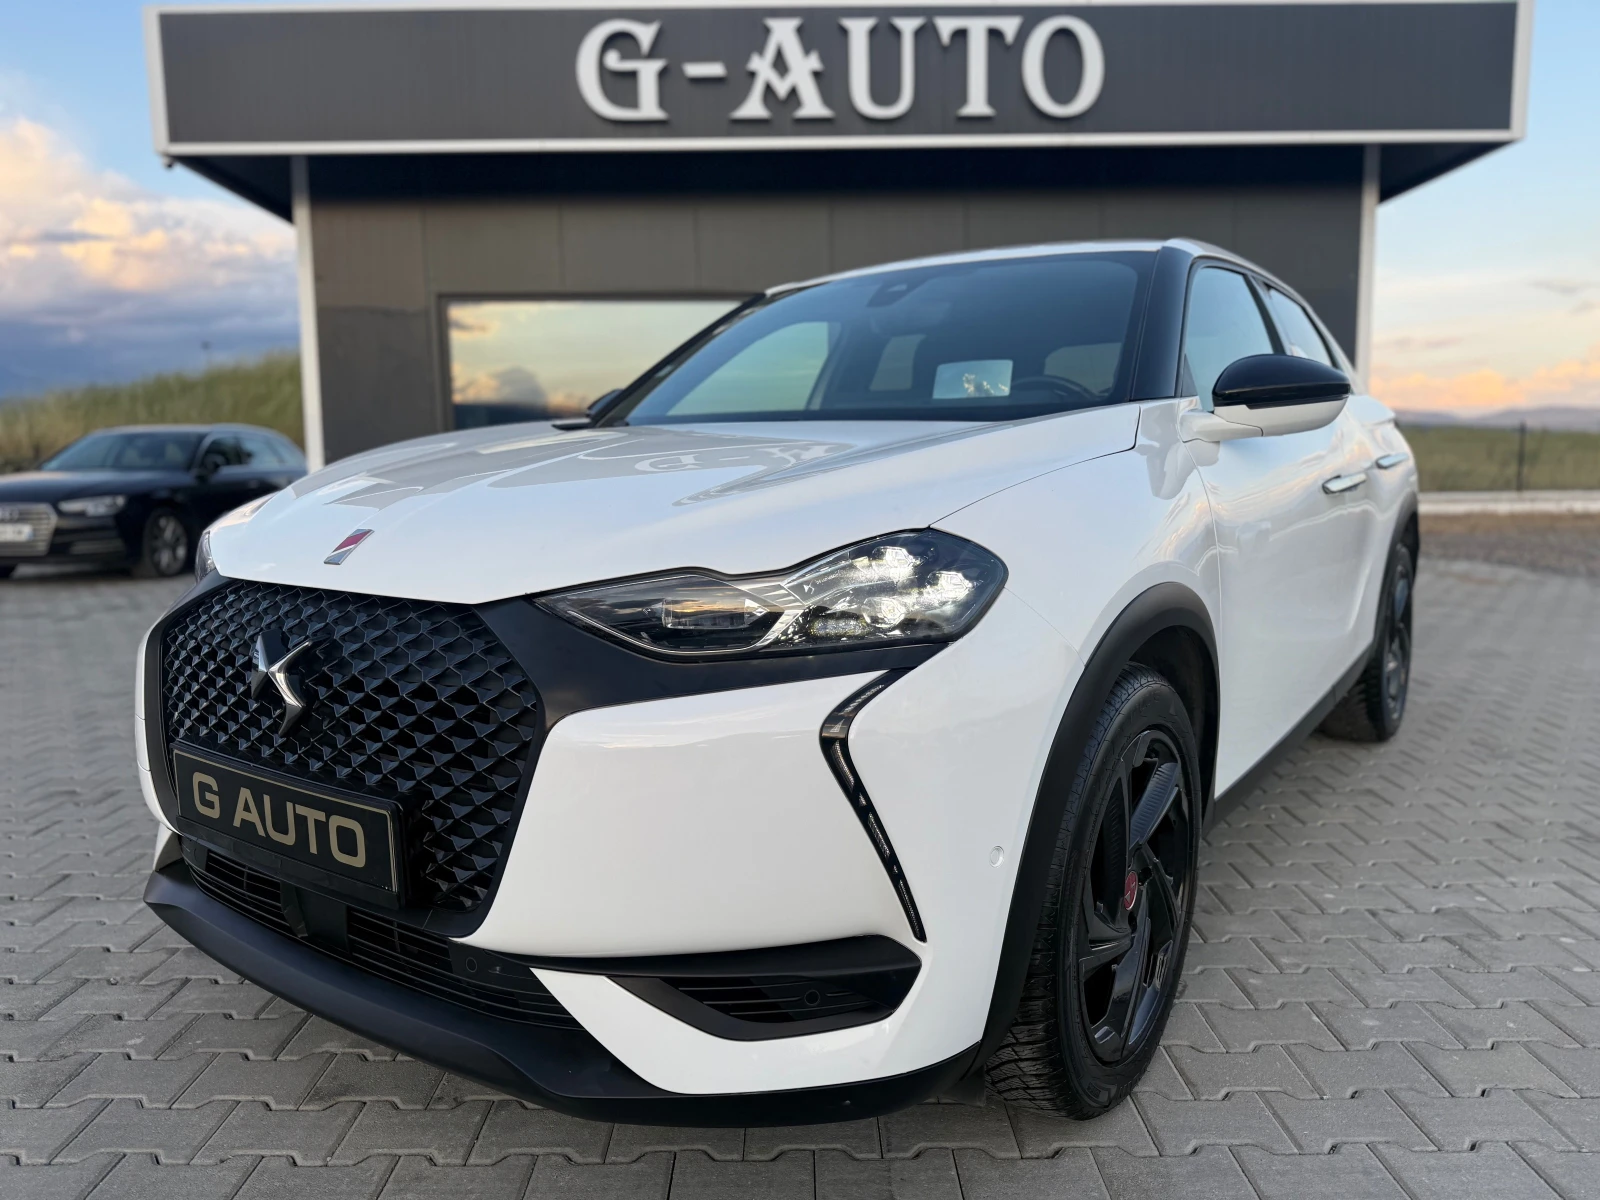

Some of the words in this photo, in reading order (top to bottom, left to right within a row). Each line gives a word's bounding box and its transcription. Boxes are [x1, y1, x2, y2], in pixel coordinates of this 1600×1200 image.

[575, 15, 1105, 121] G-AUTO
[192, 771, 221, 819] G
[232, 786, 366, 868] AUTO
